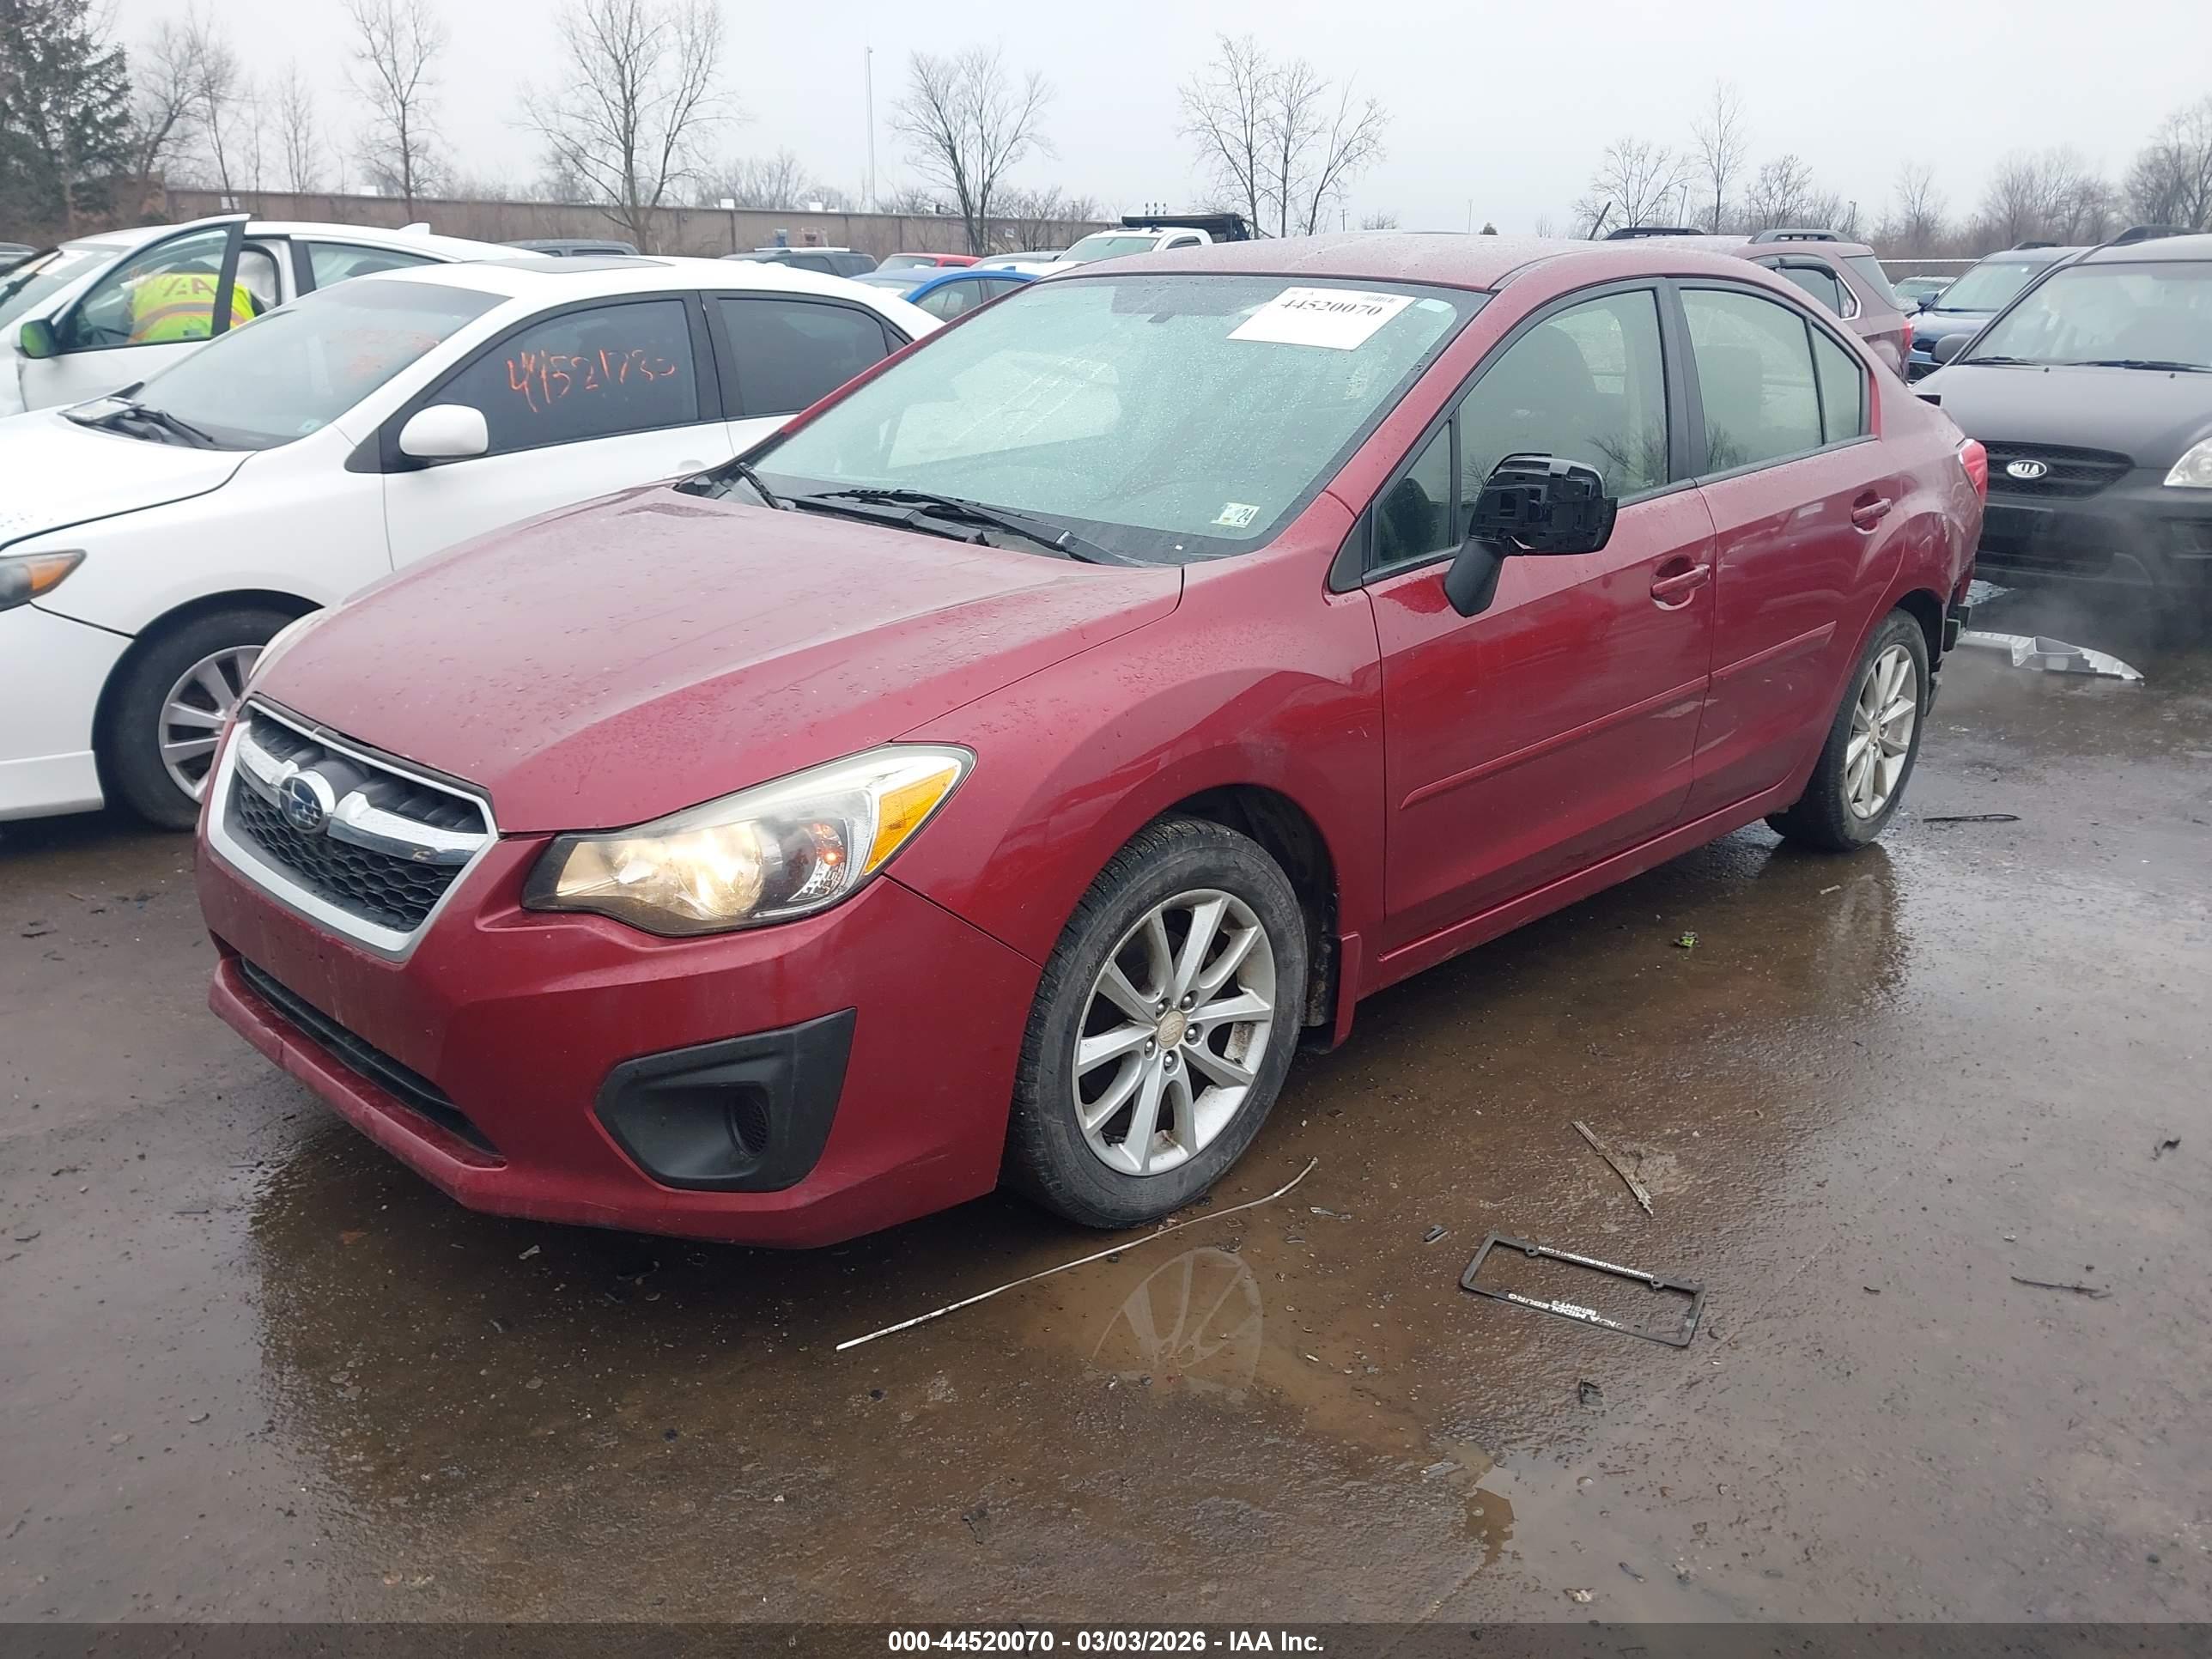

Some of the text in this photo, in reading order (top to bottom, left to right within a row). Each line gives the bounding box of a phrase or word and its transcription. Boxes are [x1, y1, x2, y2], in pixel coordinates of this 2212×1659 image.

[1280, 299, 1383, 316] 44520070
[2009, 462, 2040, 476] KIA
[1237, 507, 1255, 524] 24
[1507, 1292, 1587, 1320] MIDDLEBURG
